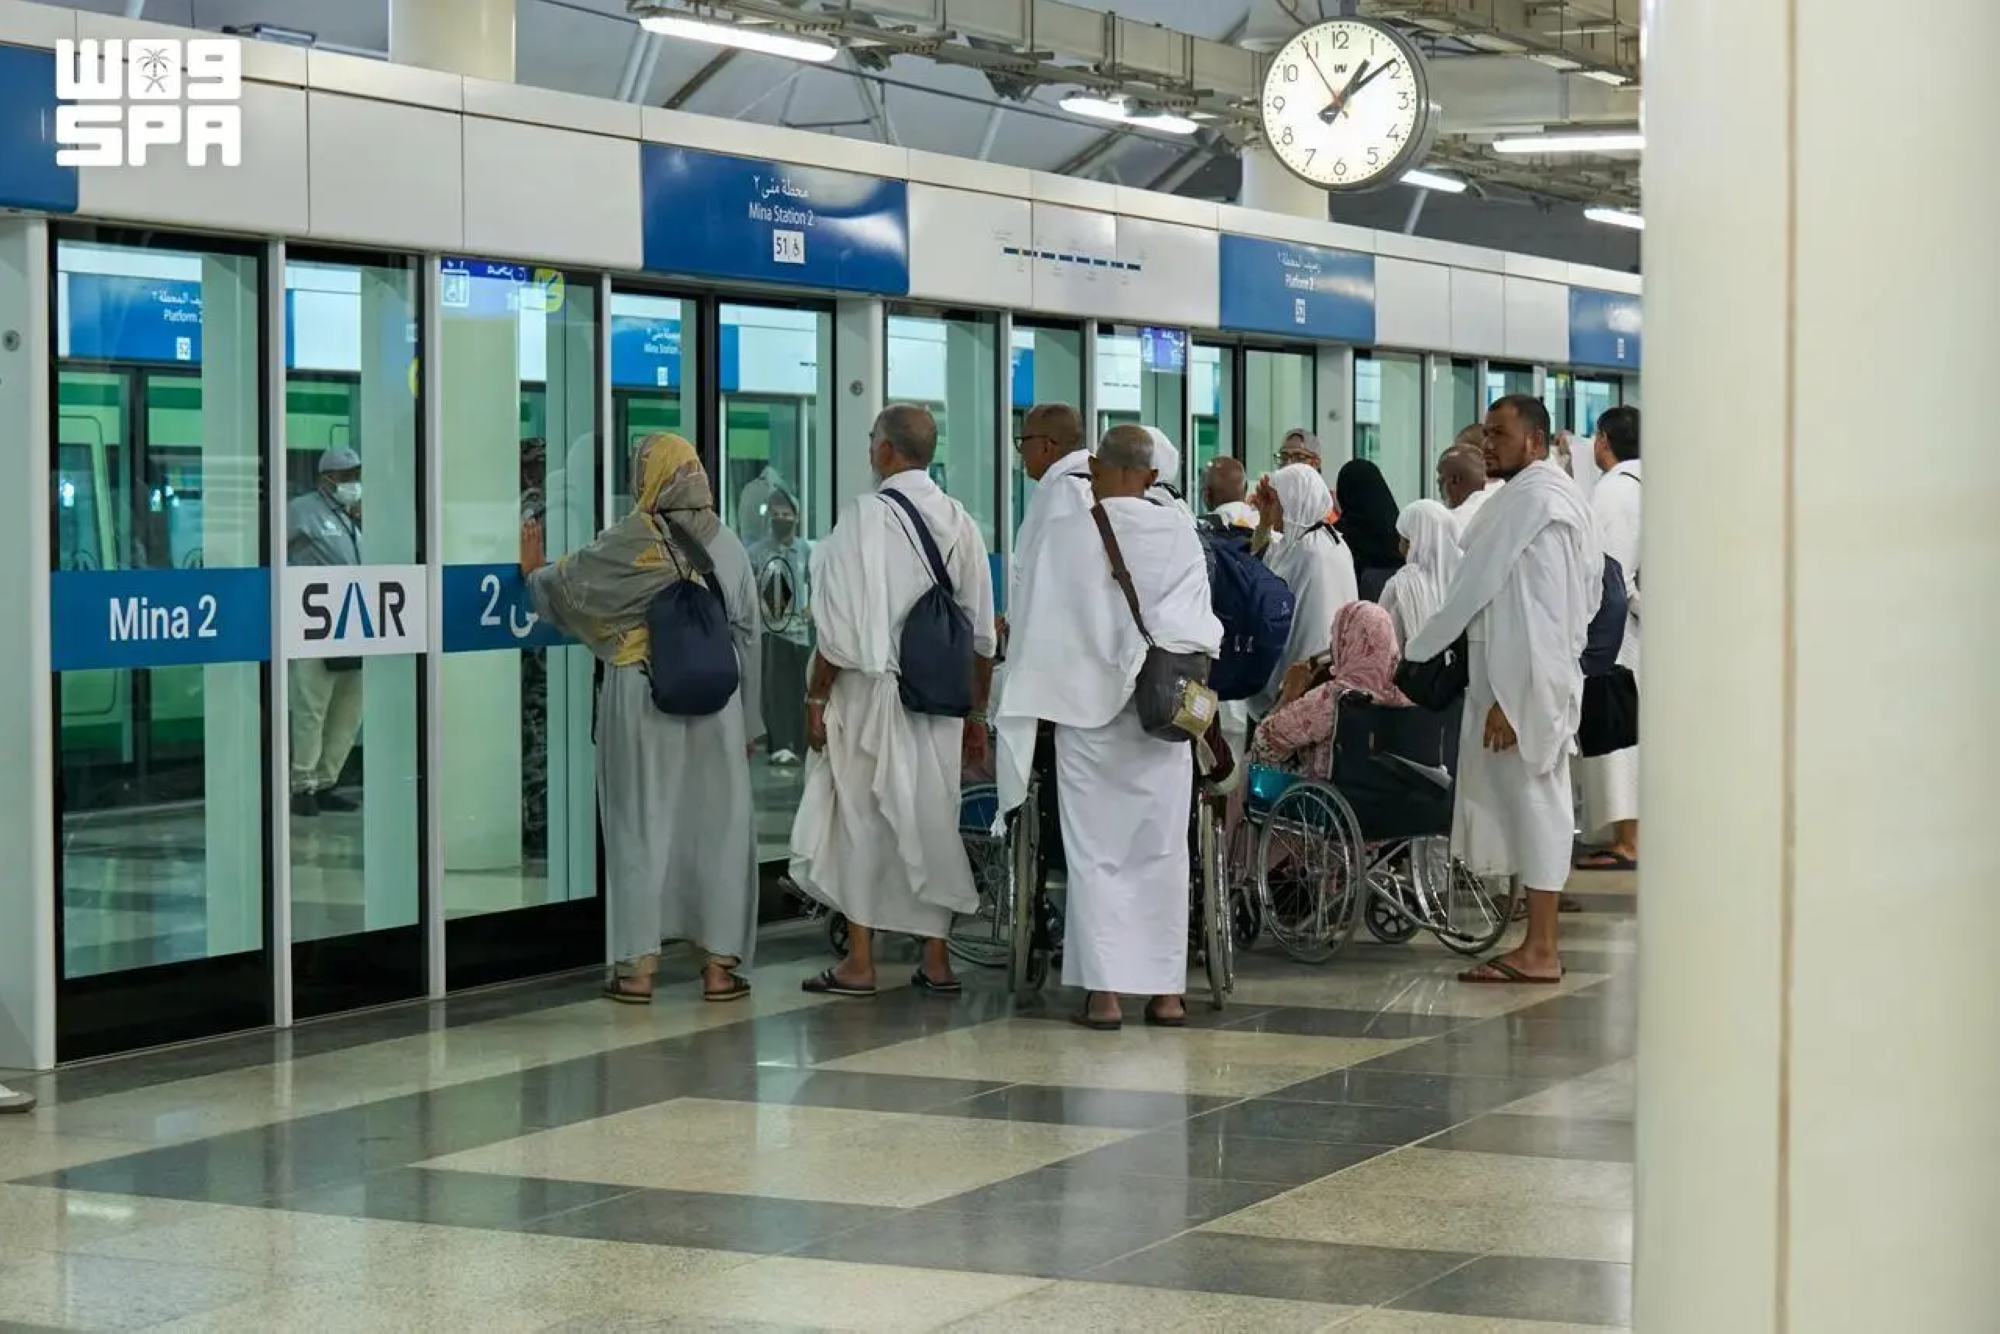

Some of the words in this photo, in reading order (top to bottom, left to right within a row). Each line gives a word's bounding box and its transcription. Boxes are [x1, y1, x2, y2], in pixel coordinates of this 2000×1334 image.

[1332, 31, 1349, 49] 12
[1306, 41, 1318, 60] 11
[1283, 64, 1298, 83] 10
[1388, 61, 1401, 79] 2
[1273, 95, 1286, 114] 9
[1397, 92, 1409, 110] 3
[1281, 126, 1293, 145] 8
[1386, 123, 1400, 142] 4
[1304, 148, 1317, 167] 7
[1366, 147, 1380, 165] 5
[1333, 157, 1347, 176] 6
[781, 175, 809, 198] محطة
[749, 201, 772, 221] Mina
[774, 204, 806, 224] Station
[807, 208, 815, 226] 2
[776, 237, 787, 255] 51
[480, 573, 501, 626] 2
[109, 596, 189, 641] Mina
[198, 593, 217, 638] 2
[302, 581, 406, 641] SAR
